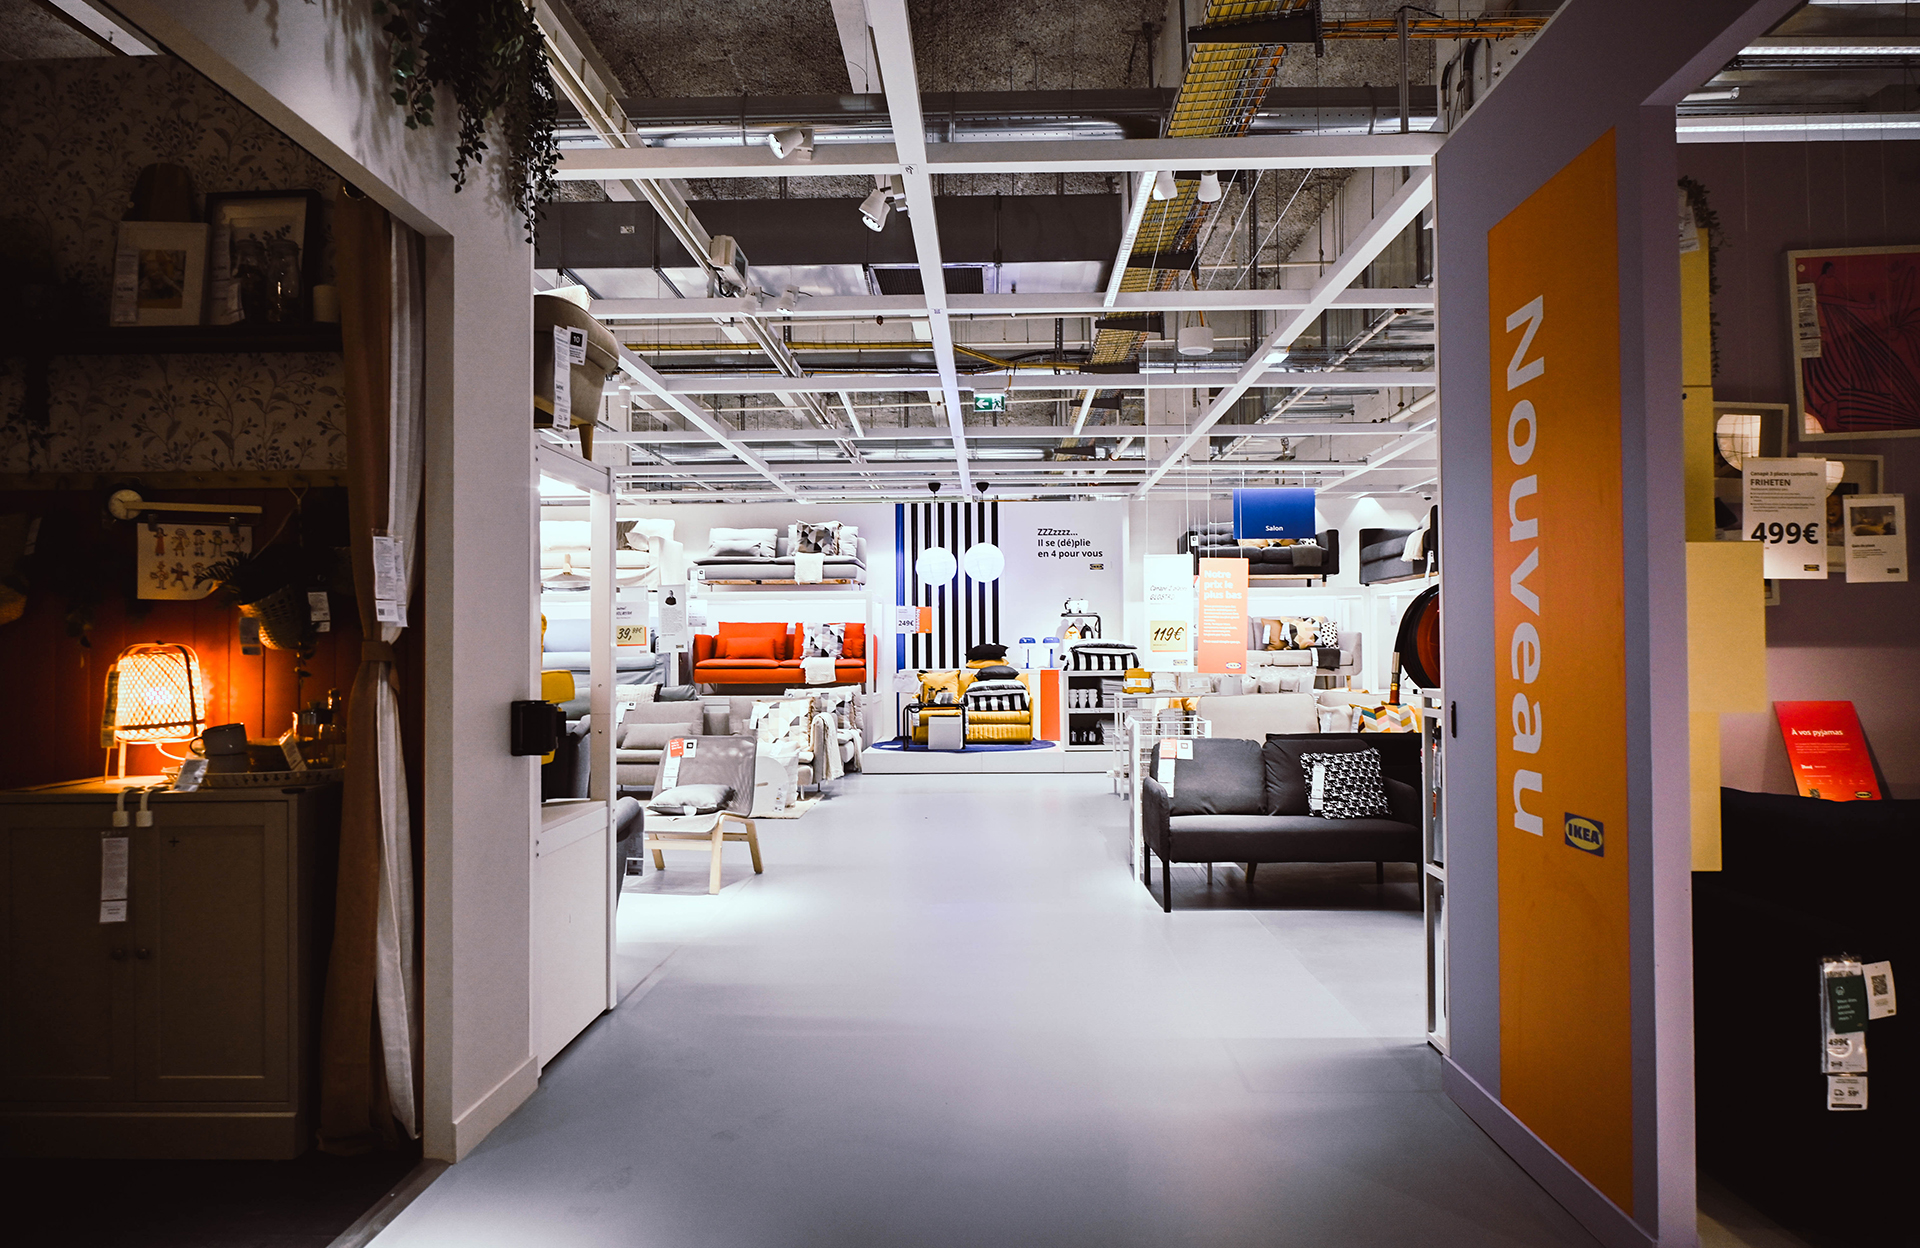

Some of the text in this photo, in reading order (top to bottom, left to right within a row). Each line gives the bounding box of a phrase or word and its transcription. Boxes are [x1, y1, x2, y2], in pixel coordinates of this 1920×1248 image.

[1751, 522, 1819, 544] 499€
[1037, 539, 1044, 547] Il
[1057, 538, 1091, 548] (dé)plie
[1058, 551, 1080, 559] pour
[1506, 294, 1545, 836] Nouveau
[1203, 570, 1232, 578] Notre
[1203, 580, 1234, 590] prix le
[1203, 590, 1242, 600] plus bas
[1153, 626, 1184, 641] 119€
[1812, 729, 1843, 737] pyjamas
[1568, 823, 1600, 845] IKEA
